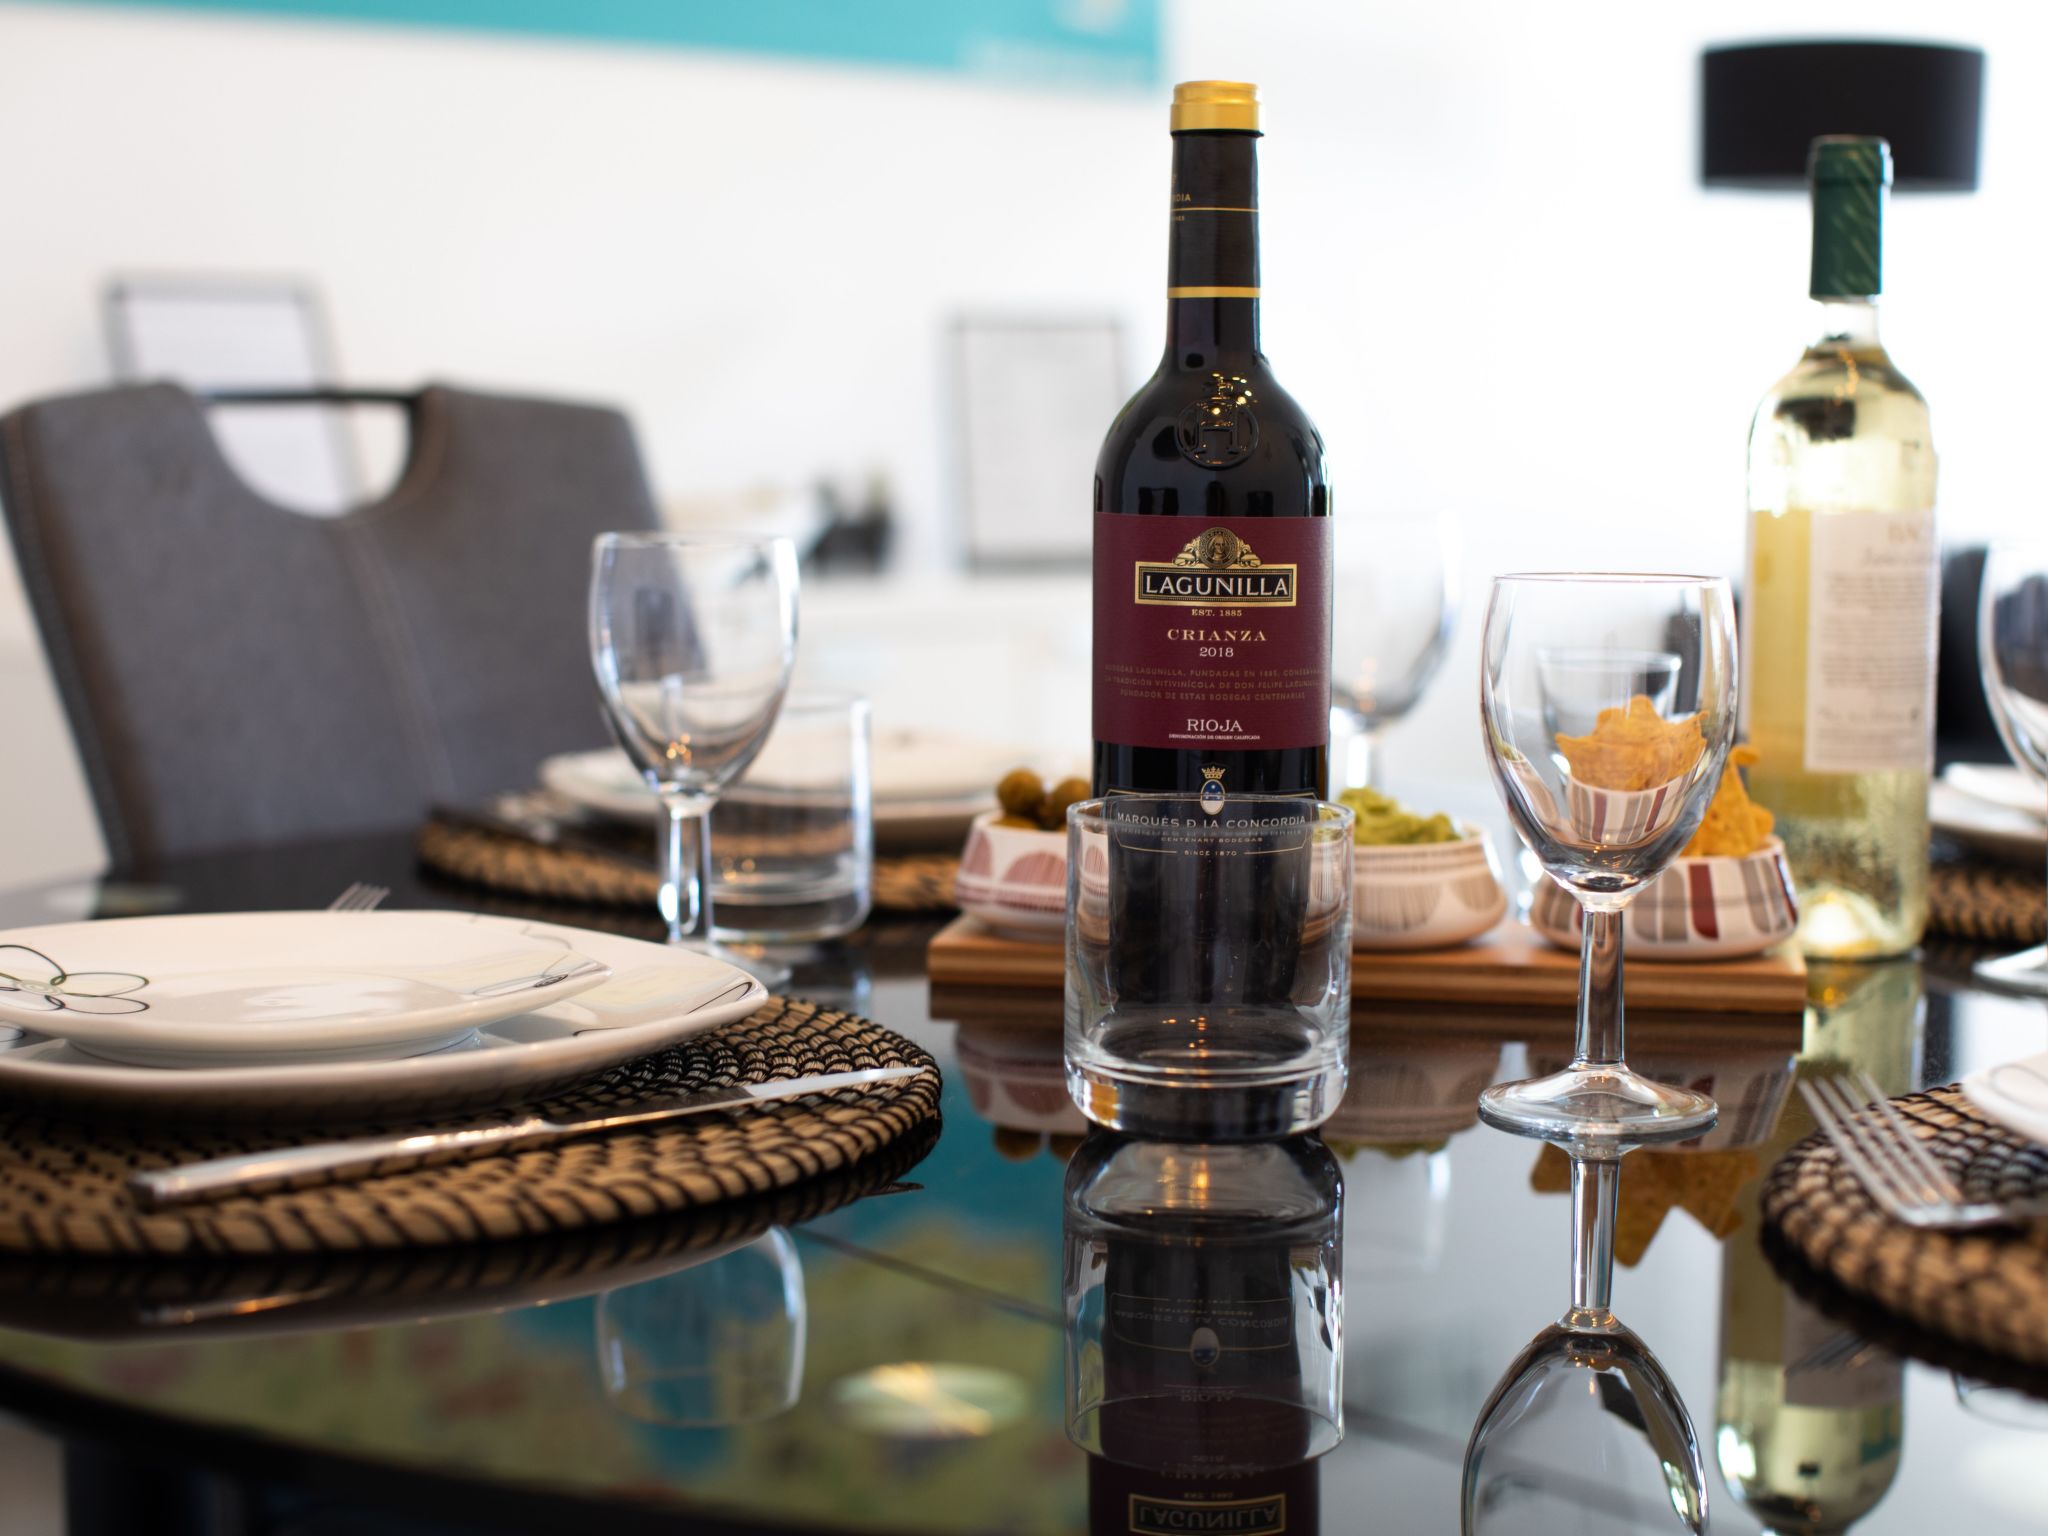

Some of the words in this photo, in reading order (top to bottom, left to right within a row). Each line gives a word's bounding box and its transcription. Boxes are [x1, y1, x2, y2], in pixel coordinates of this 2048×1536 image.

[1145, 575, 1290, 597] LAGUNILLA
[1191, 608, 1215, 617] EST.
[1219, 609, 1242, 618] 1885
[1166, 628, 1268, 642] CRIANZA
[1199, 647, 1234, 658] 2018
[1187, 718, 1244, 732] RIOJA
[1226, 815, 1306, 829] CONCORDIA
[1218, 836, 1264, 844] BODEGAS
[1184, 849, 1211, 857] SINCE
